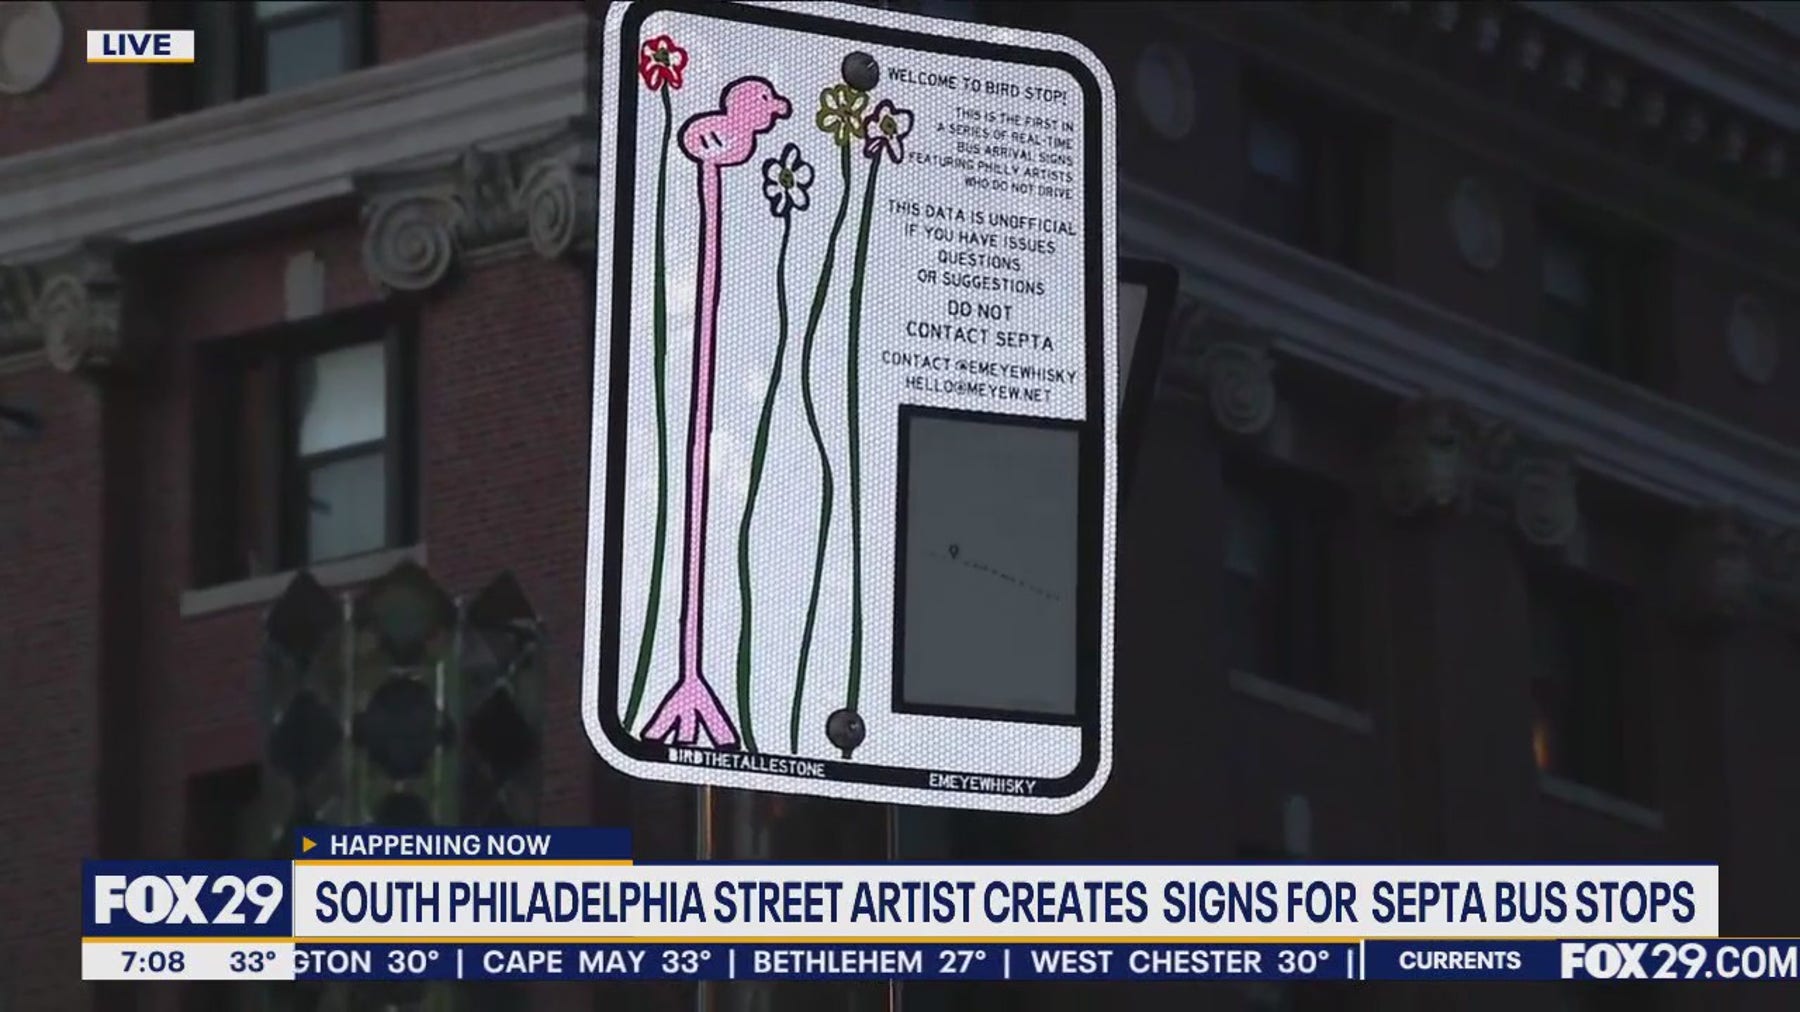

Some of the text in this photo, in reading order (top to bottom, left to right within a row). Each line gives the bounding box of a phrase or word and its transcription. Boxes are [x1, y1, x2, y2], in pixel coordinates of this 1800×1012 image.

[887, 68, 1068, 106] WELCOME TO BIRD STOP!
[955, 108, 1074, 132] THIS IS THE FIRST IN
[937, 122, 1073, 149] A SERIES OF REAL-TIME
[957, 141, 1073, 166] BUS ARRIVAL SIGNS
[908, 152, 1073, 183] FEATURING PHILLY ARTISTS
[965, 176, 1073, 200] WHO DO NOT DRIVE
[888, 200, 1077, 236] THIS DATA IS UNOFFICIAL
[904, 223, 1057, 254] IF YOU HAVE ISSUES
[938, 250, 1021, 272] QUESTIONS
[917, 268, 1046, 296] OR SUGGESTIONS
[947, 300, 1013, 321] DO NOT
[906, 320, 1054, 351] CONTACT SEPTA
[882, 351, 950, 371] CONTACT
[668, 748, 826, 778] BIRDTHETALLESTONE
[929, 772, 1037, 795] EMEYEWHISKY
